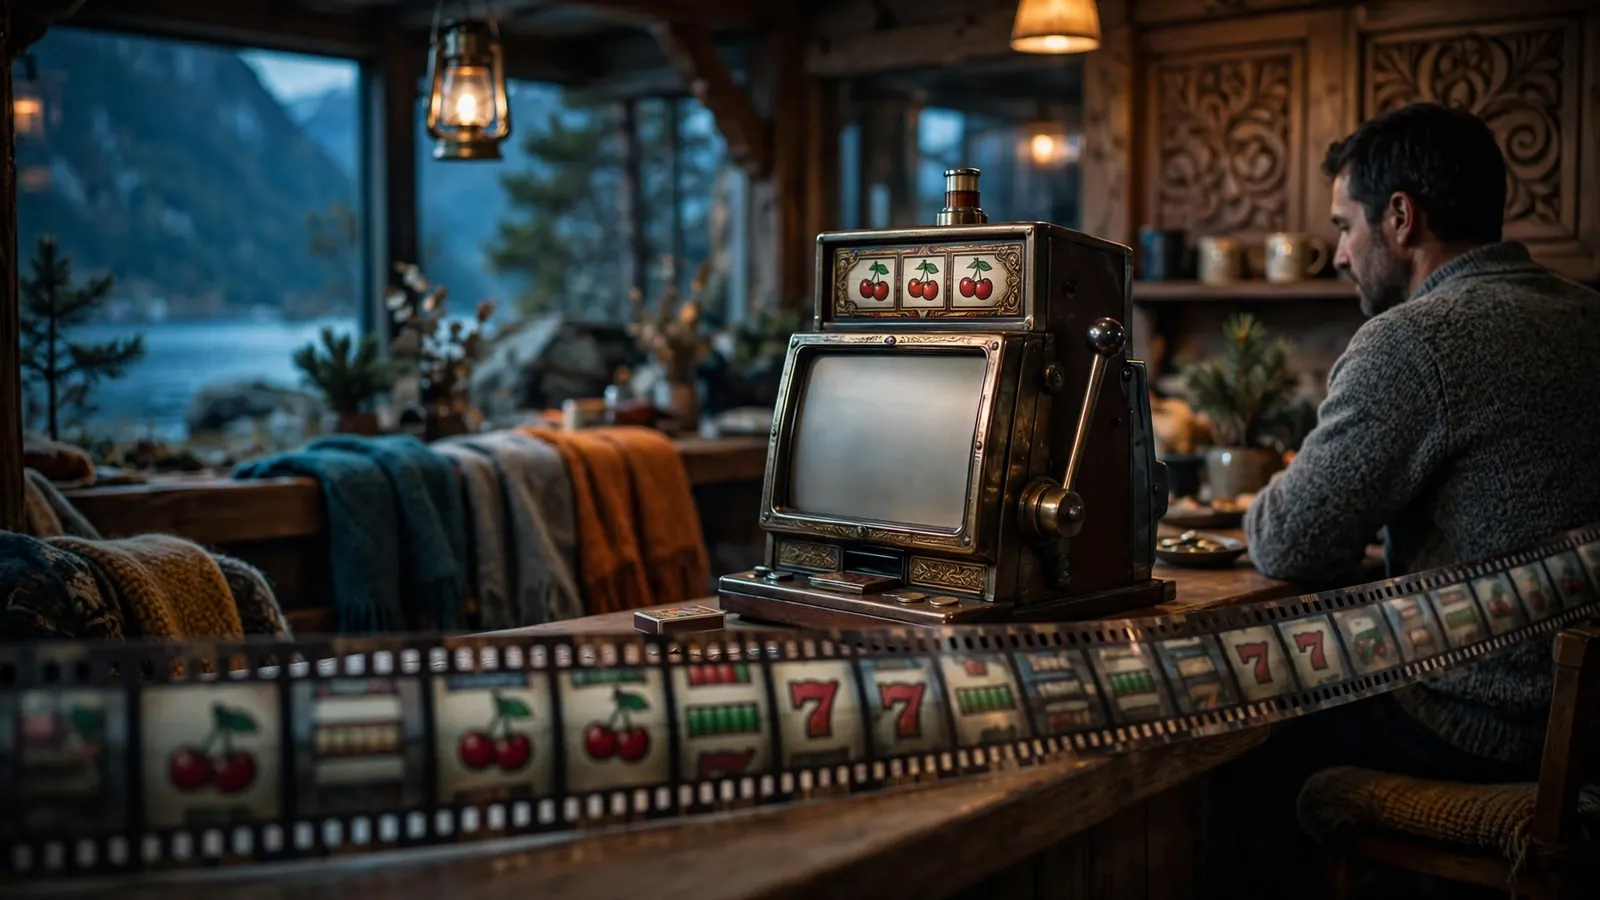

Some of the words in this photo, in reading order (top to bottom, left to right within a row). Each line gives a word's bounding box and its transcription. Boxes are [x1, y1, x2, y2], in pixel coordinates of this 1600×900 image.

[1235, 641, 1273, 685] 7
[1293, 630, 1329, 671] 7
[788, 679, 838, 739] 7
[879, 682, 925, 739] 7
